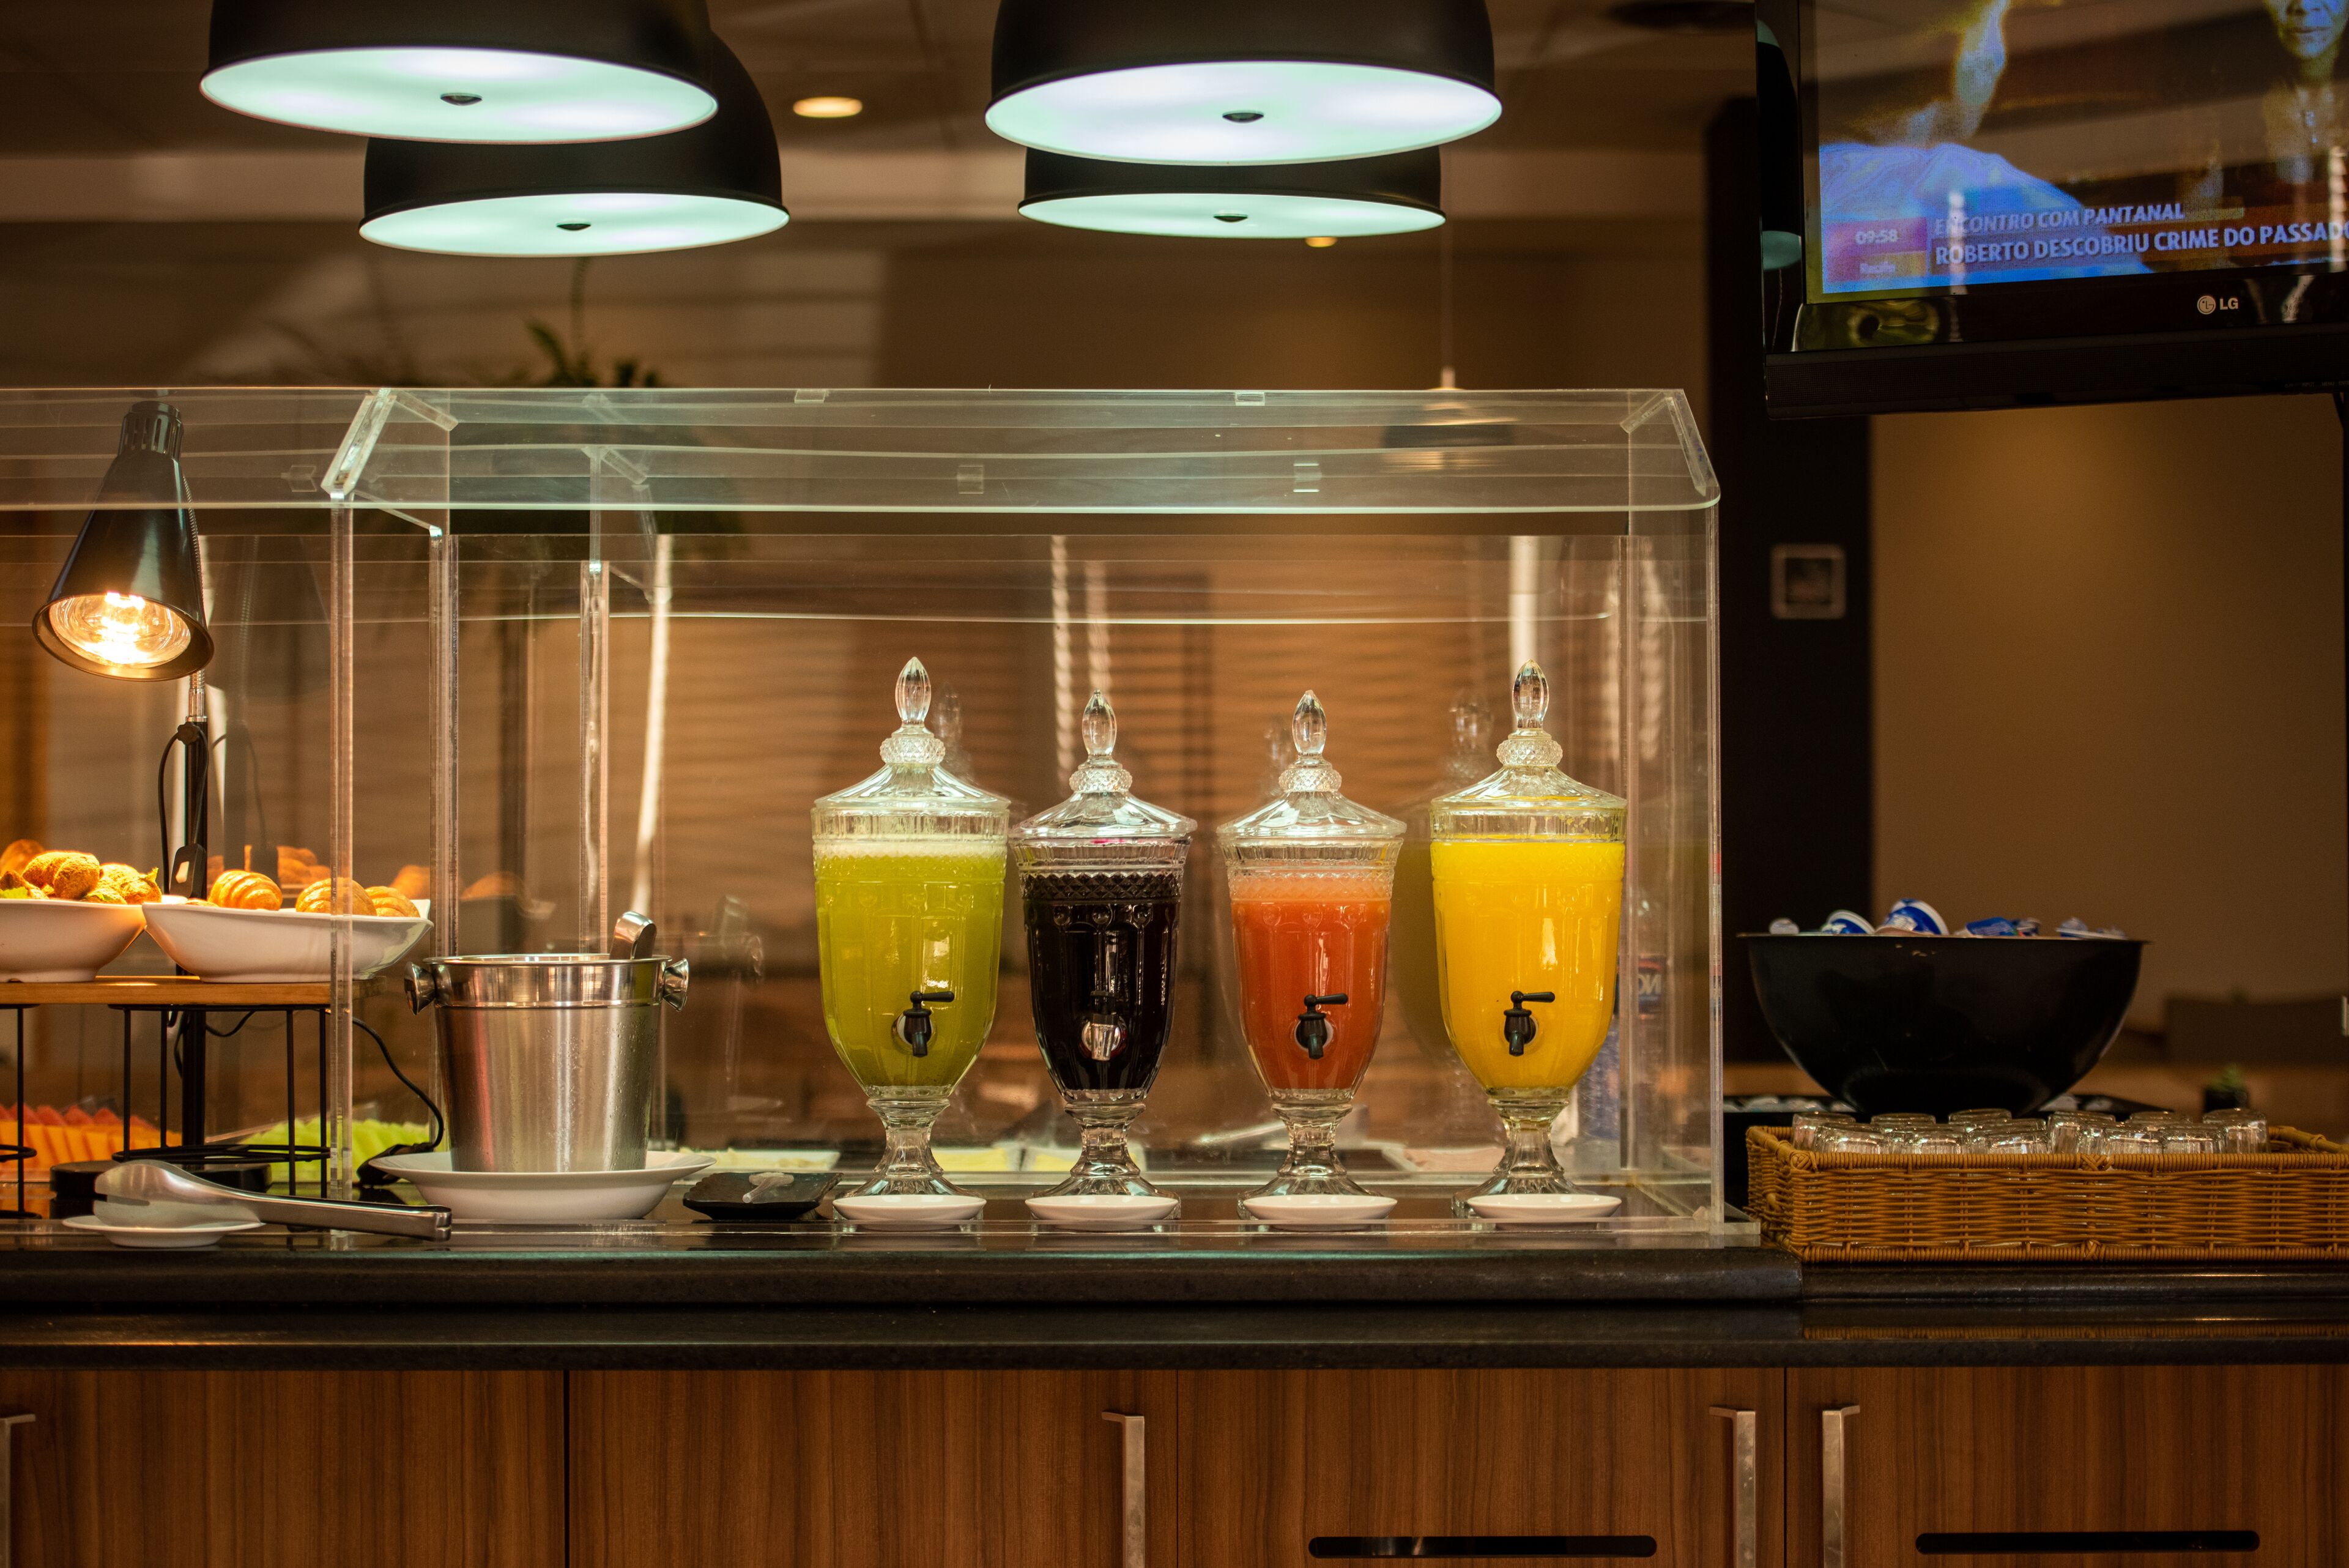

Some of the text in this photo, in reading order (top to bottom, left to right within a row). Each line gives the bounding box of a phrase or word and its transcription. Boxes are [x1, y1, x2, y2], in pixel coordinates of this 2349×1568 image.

[1935, 203, 2185, 235] ECONTRO COM PANTANAL
[1855, 229, 1899, 245] 09:58
[1935, 242, 2029, 265] ROBERTO
[2034, 234, 2149, 258] DESCOBRIU
[2154, 229, 2219, 251] CRIME
[2224, 226, 2255, 247] DO
[2219, 298, 2239, 310] LG
